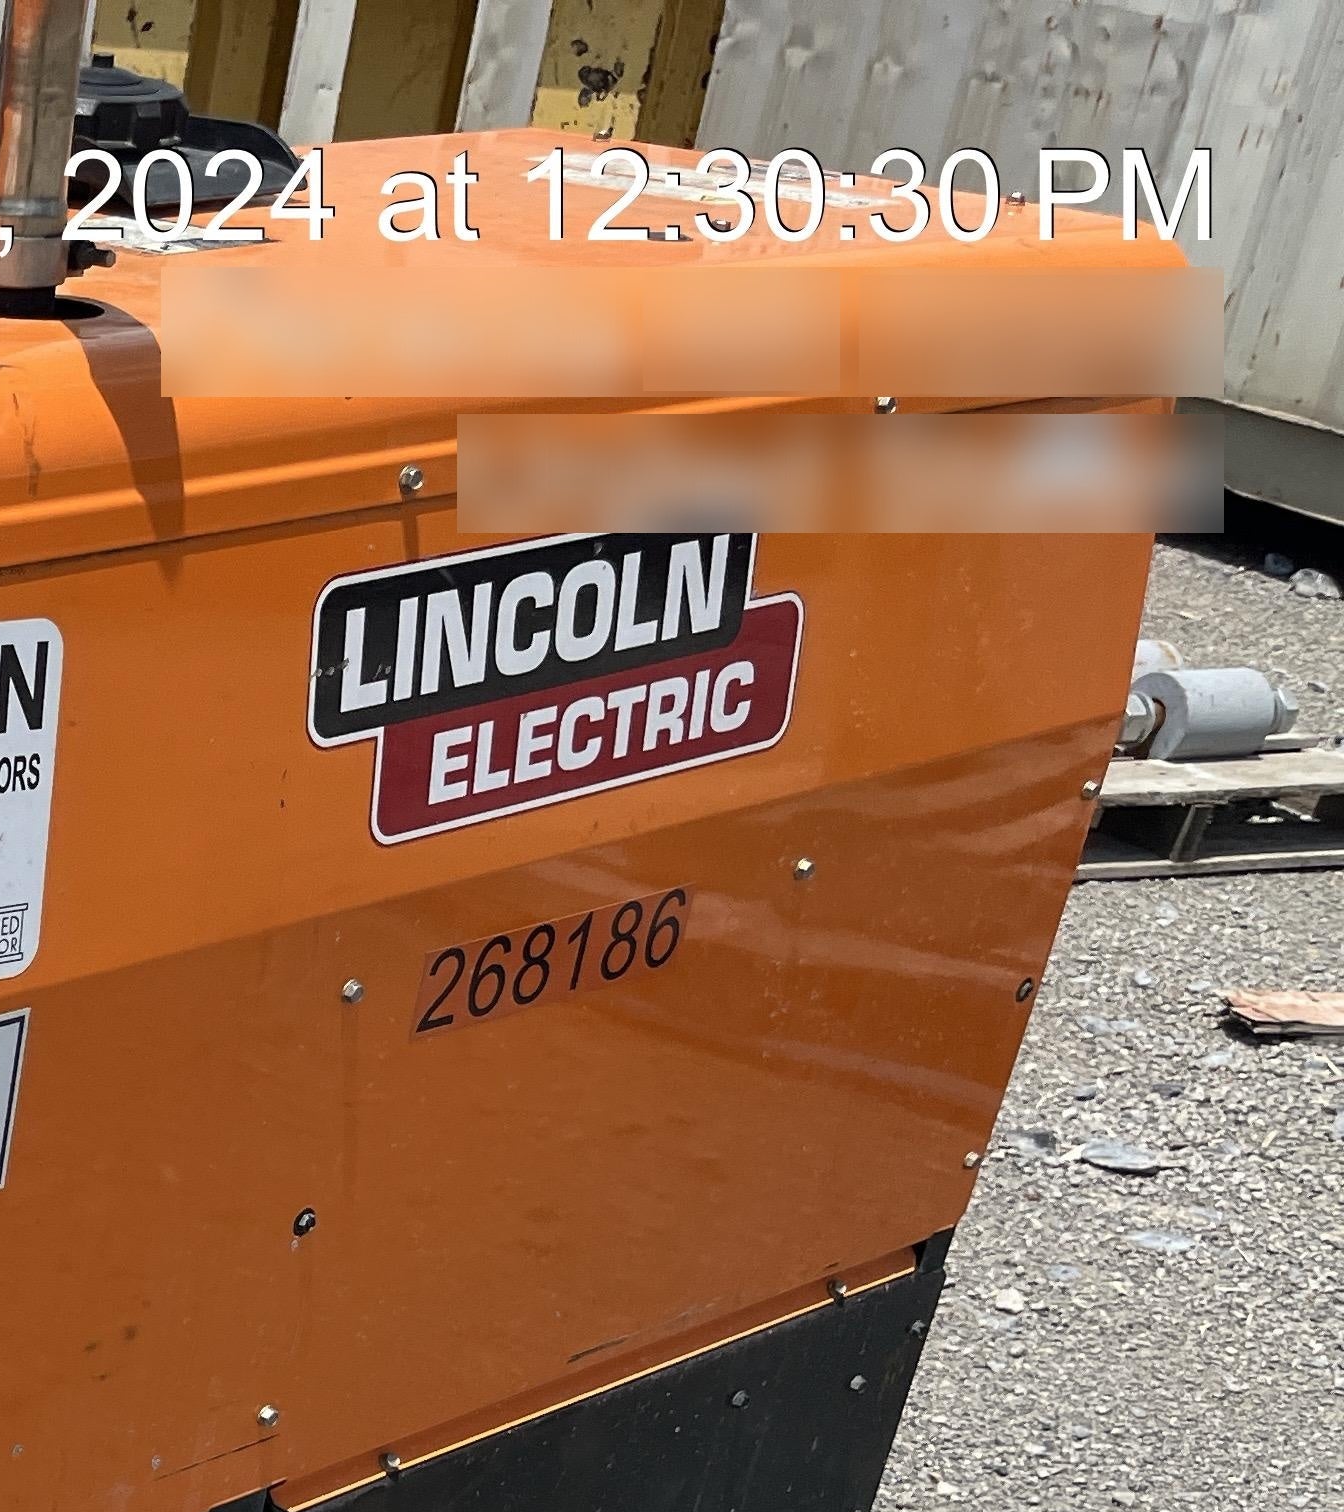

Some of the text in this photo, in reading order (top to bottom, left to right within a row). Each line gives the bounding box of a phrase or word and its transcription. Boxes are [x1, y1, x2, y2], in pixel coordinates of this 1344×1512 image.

[339, 533, 731, 714] LINCOLN
[427, 659, 755, 806] ELECTRIC
[415, 887, 687, 1035] 268186
